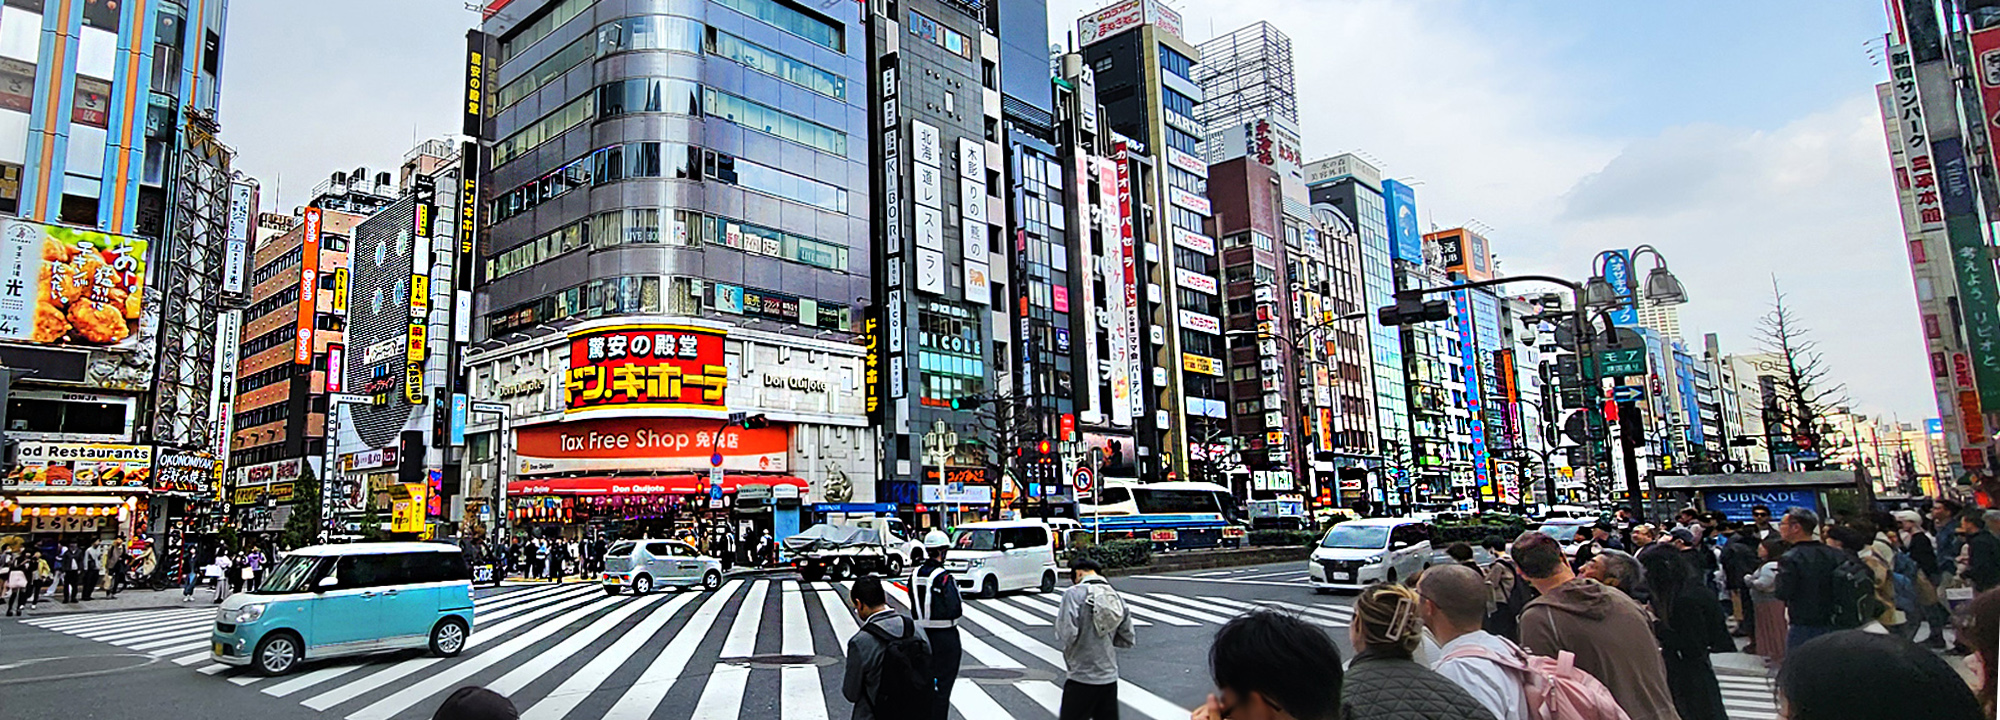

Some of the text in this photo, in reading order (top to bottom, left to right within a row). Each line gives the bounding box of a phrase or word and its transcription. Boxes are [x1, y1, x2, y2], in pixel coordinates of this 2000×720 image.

[468, 51, 481, 115] 驚安の殿堂
[1892, 51, 1924, 148] 新宿サンパーク
[1165, 108, 1205, 137] DARTS
[1117, 150, 1131, 203] カラオケ
[887, 161, 897, 250] KIBORI
[921, 129, 936, 287] 北海道レストラン
[967, 147, 981, 257] 木彫りの熊の
[1120, 216, 1134, 268] パセラ
[73, 241, 94, 287] チキンが
[6, 278, 24, 297] 光
[51, 260, 69, 304] たべたい。
[890, 292, 899, 347] Nicole
[587, 334, 698, 359] 驚安の殿堂
[919, 331, 981, 355] NICOLE
[1604, 351, 1637, 363] モア
[408, 362, 422, 401] CASINO
[499, 384, 514, 397] Don
[764, 373, 828, 393] Don Quijote
[1131, 365, 1140, 405] パーティー
[62, 393, 98, 402] MONJA
[49, 445, 149, 460] Restaurants
[561, 430, 739, 451] Tax Free Shop 免税店
[160, 454, 215, 470] OKONOMIYAKI
[160, 467, 207, 485] お好み焼き
[613, 485, 665, 494] Don Quijote
[1717, 491, 1801, 503] SUBNADE
